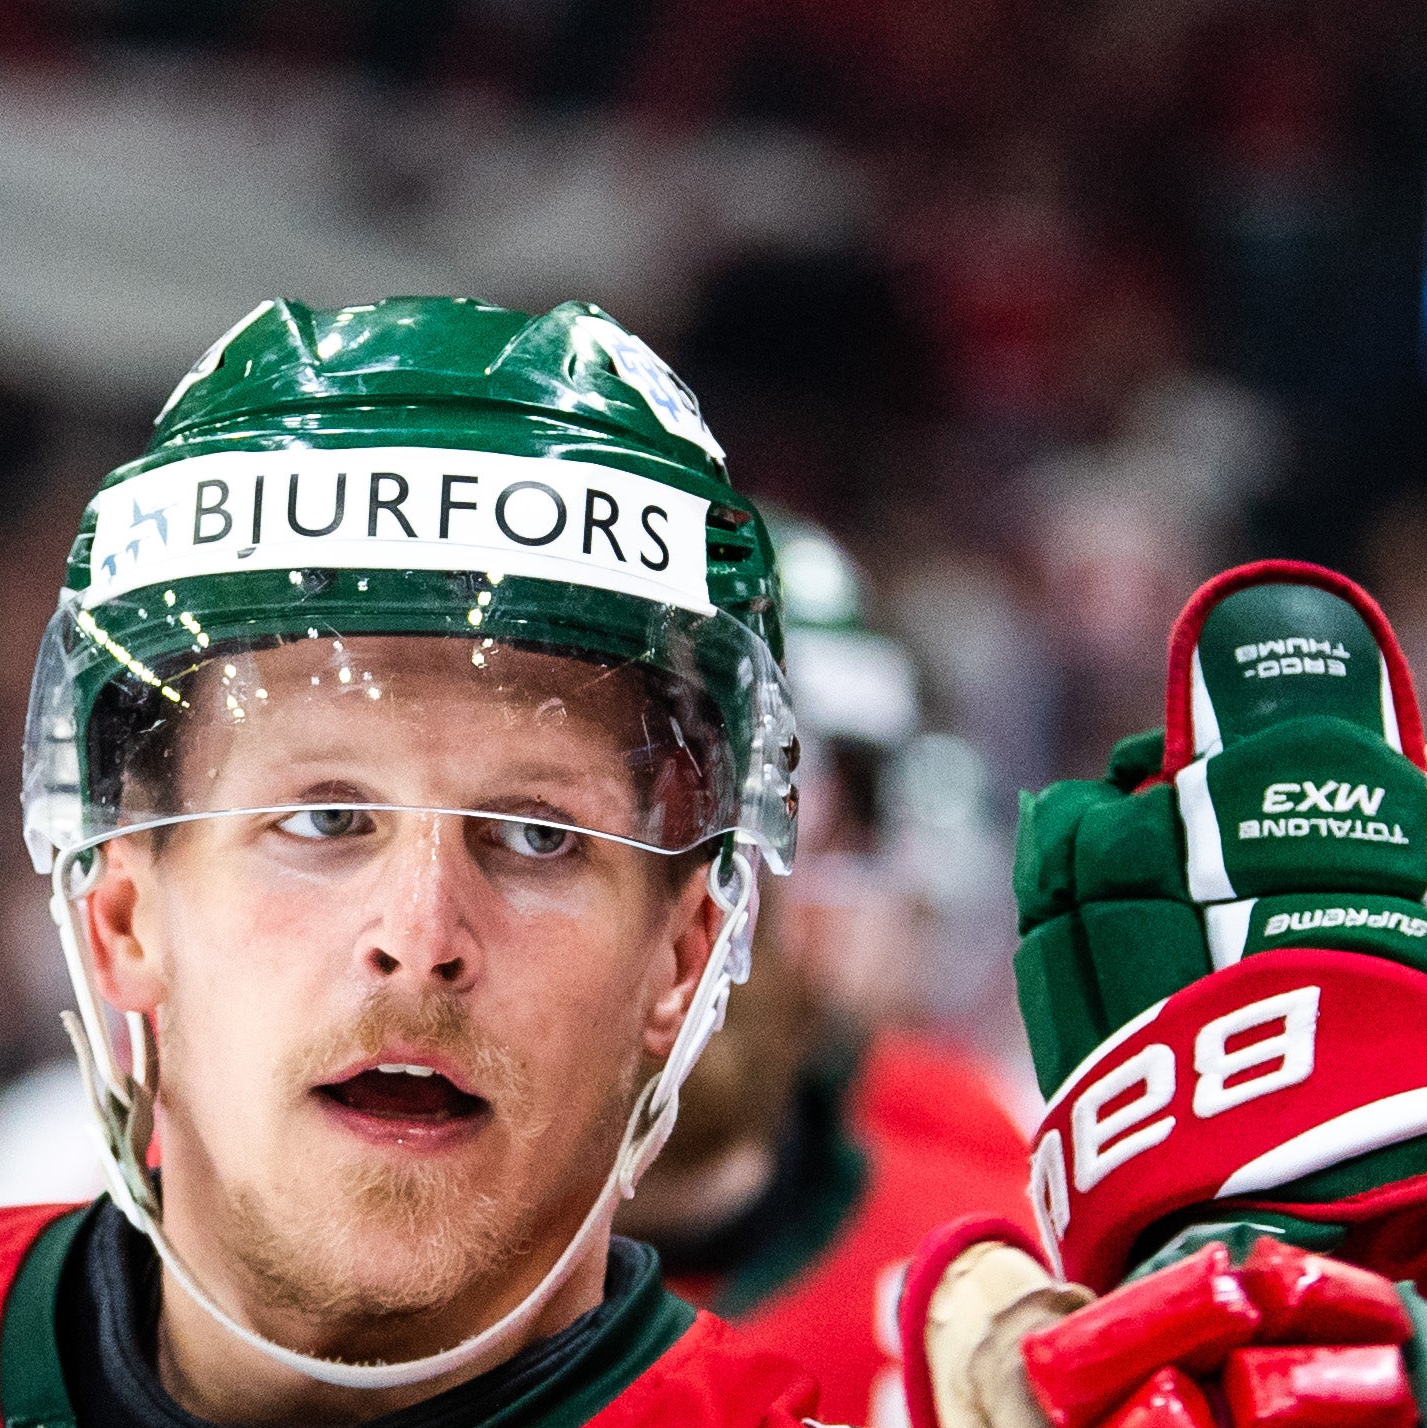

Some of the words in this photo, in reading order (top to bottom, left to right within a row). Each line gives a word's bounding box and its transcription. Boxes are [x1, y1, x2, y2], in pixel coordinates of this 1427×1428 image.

[191, 471, 672, 573] BJURFORS
[1262, 778, 1387, 818] MX3
[1236, 818, 1411, 846] TOTALONE
